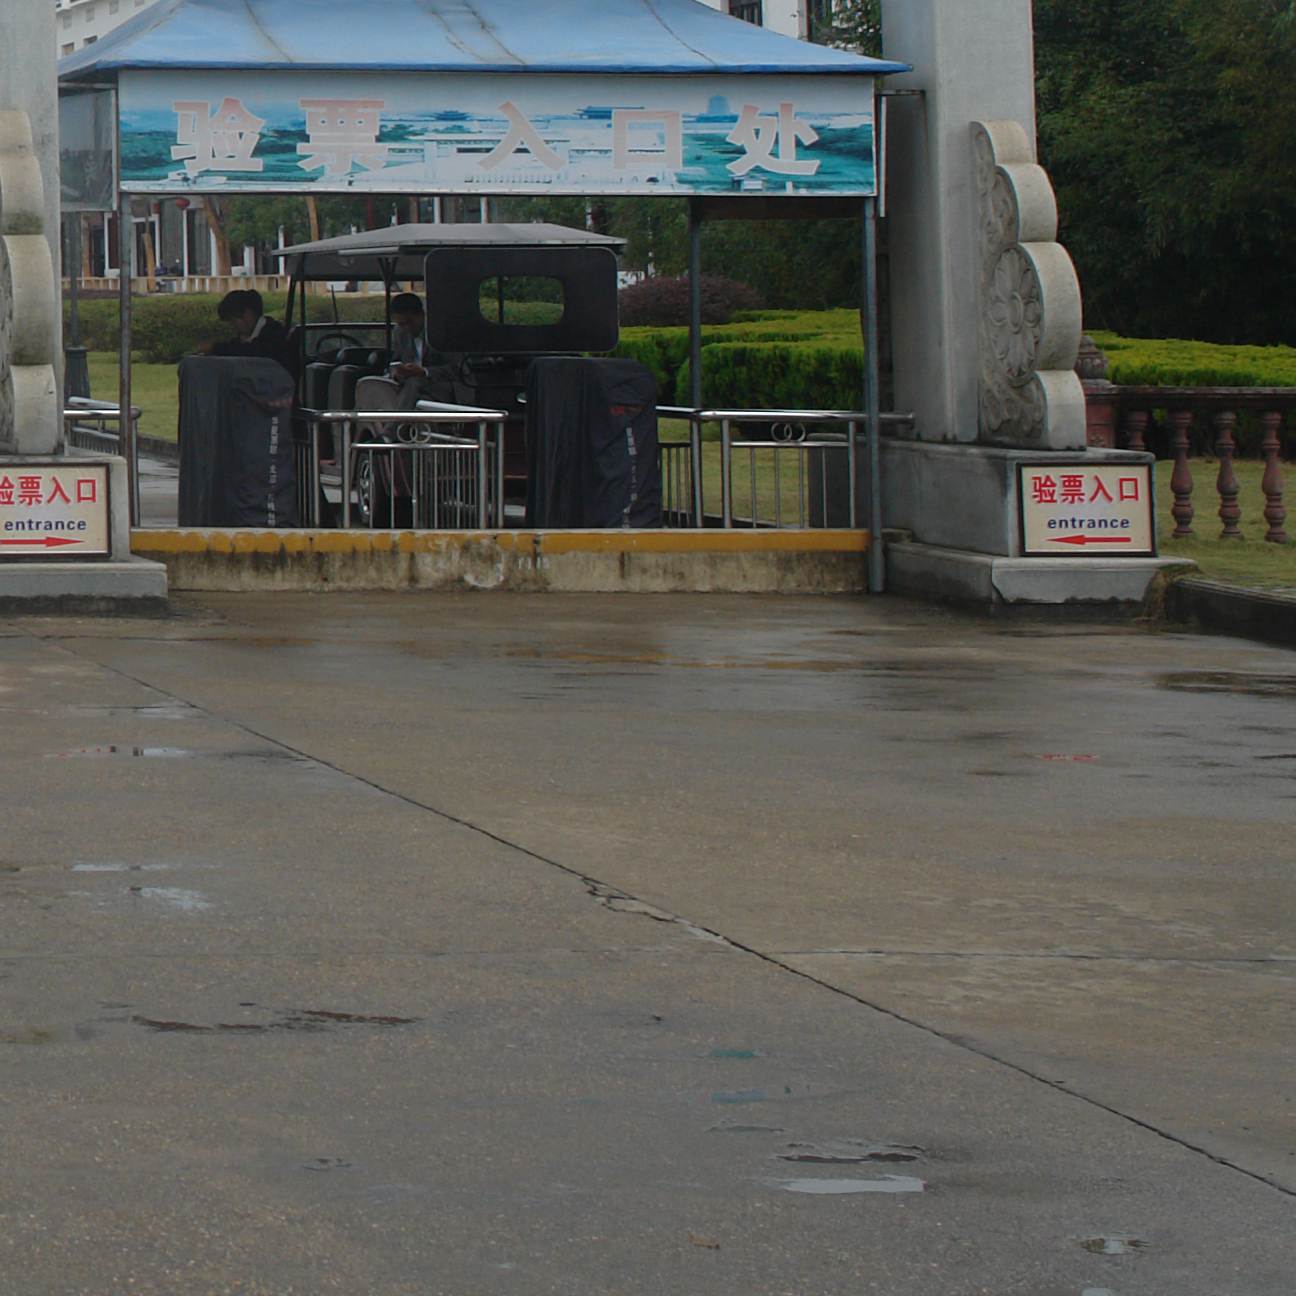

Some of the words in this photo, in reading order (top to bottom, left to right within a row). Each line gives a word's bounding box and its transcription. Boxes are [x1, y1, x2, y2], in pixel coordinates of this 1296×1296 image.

[169, 96, 821, 176] 验票入口处
[1032, 474, 1139, 504] 验票入口
[3, 518, 87, 531] entrance
[1047, 517, 1130, 529] entrance
